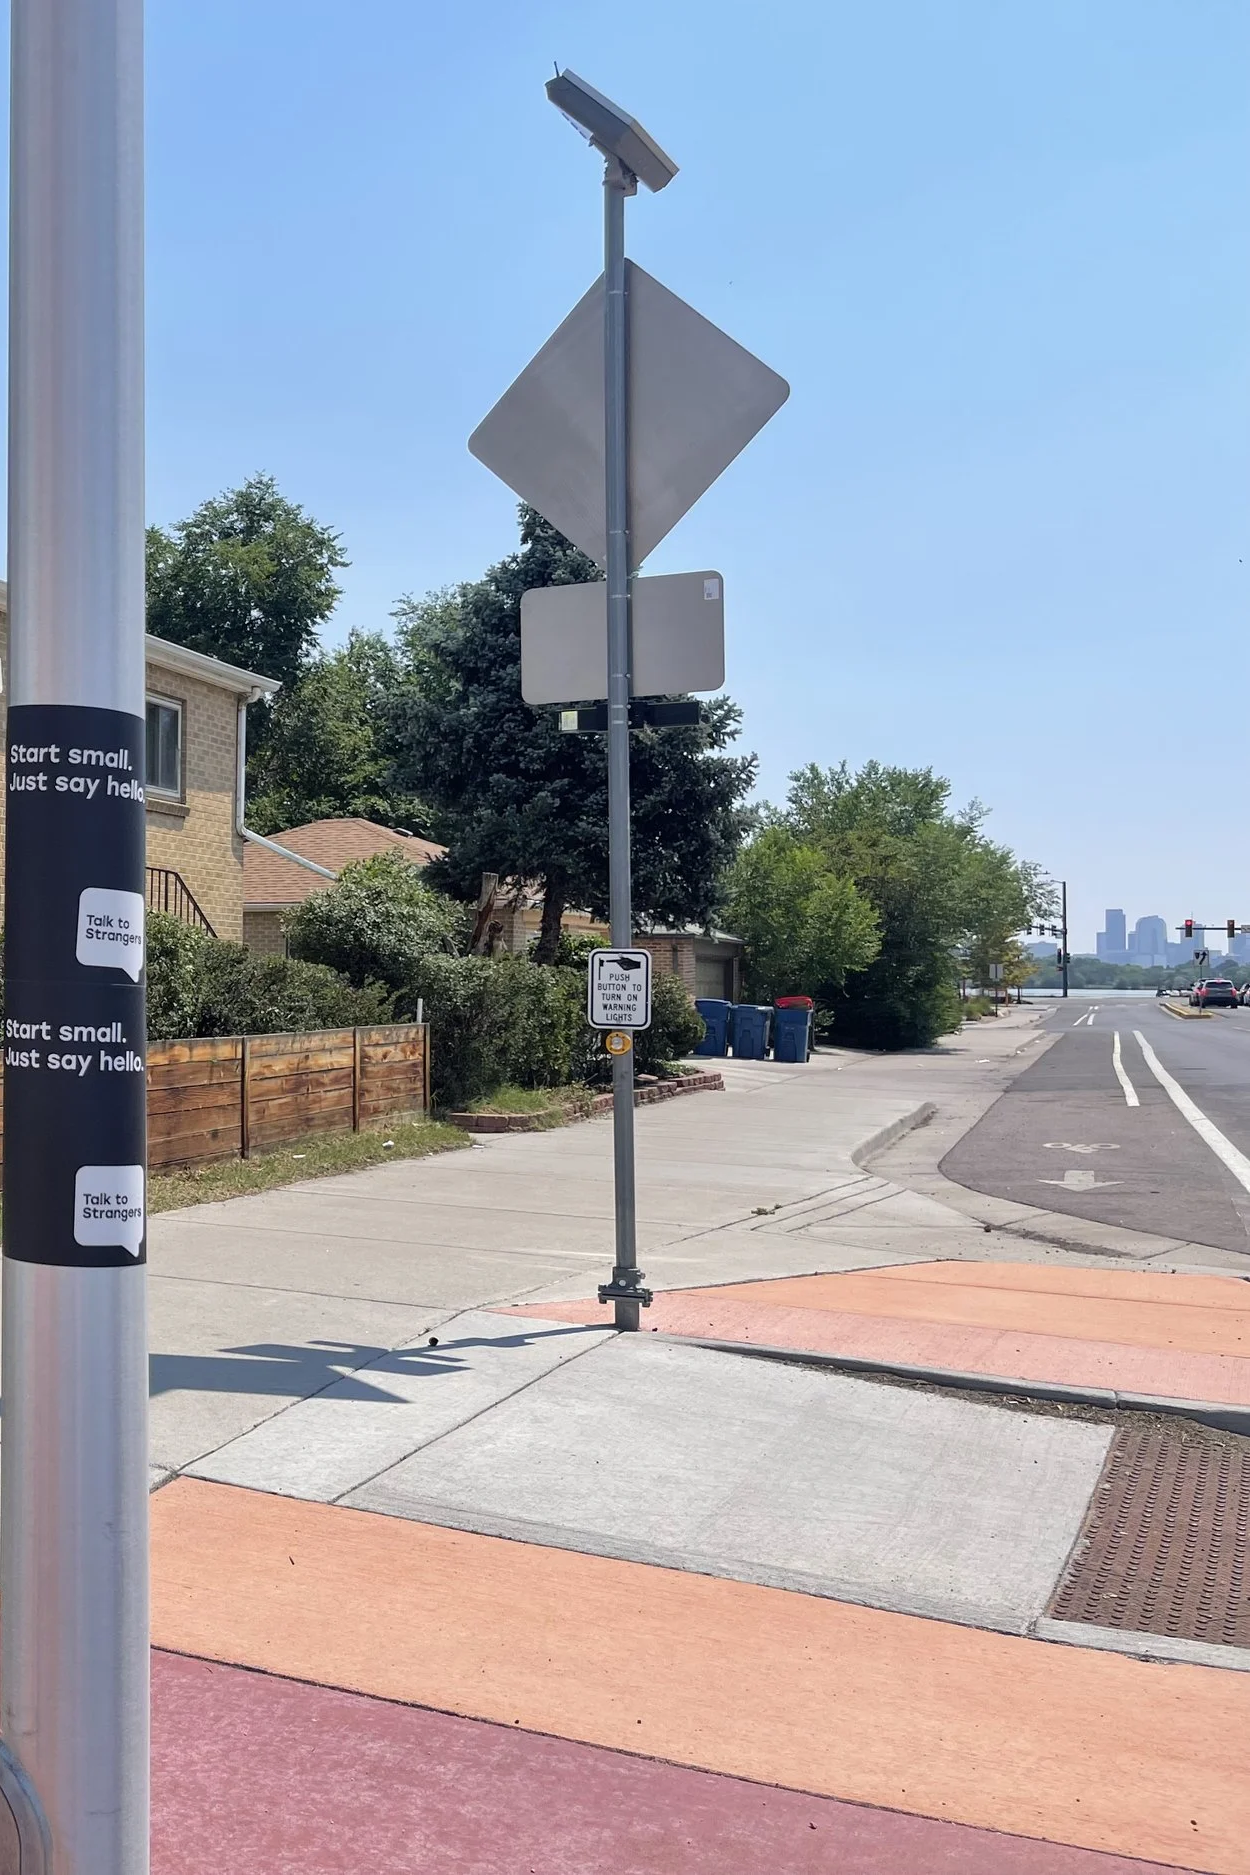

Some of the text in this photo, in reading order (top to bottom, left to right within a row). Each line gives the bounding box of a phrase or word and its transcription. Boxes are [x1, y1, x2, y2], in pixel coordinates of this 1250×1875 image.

[10, 744, 132, 771] Start small.
[10, 772, 48, 792] Just
[55, 775, 100, 800] say
[86, 914, 130, 930] Talk to
[86, 928, 142, 946] Strangers
[632, 984, 642, 992] TO
[602, 1004, 636, 1012] WARNING
[6, 1018, 127, 1044] Start small.
[6, 1047, 144, 1076] Just say hello.
[83, 1193, 128, 1205] Talk to
[82, 1208, 142, 1222] Strangers
